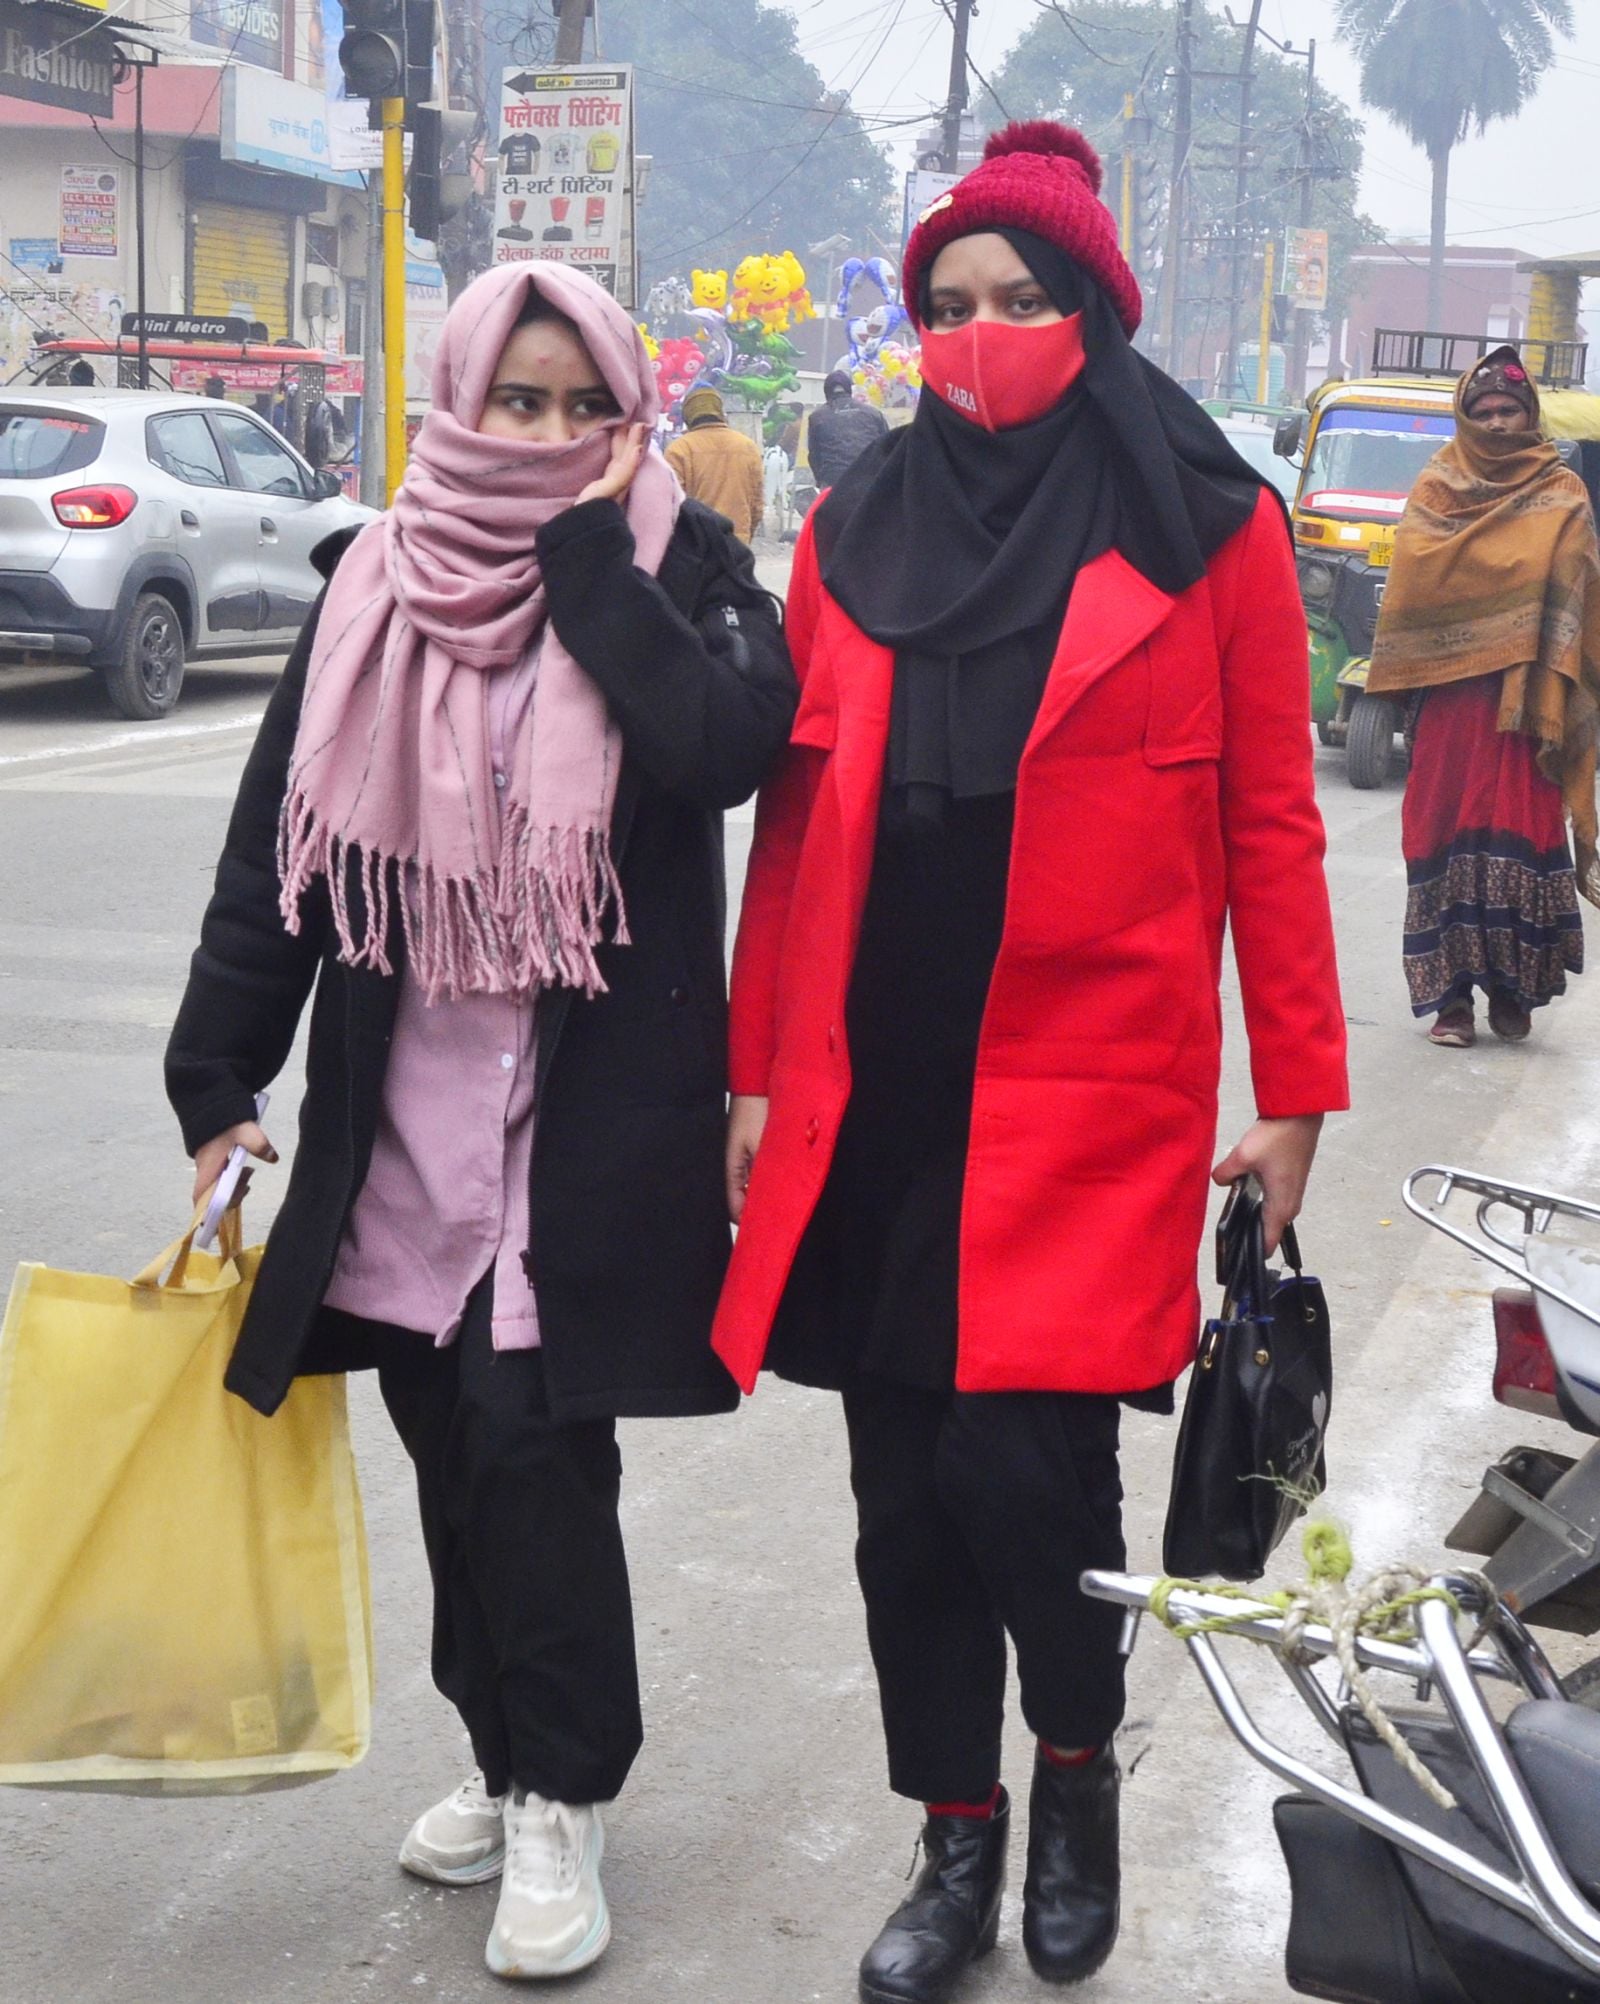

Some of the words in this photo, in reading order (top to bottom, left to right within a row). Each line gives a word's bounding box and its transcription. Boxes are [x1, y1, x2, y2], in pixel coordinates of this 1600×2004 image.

[227, 5, 279, 41] BRIDES
[0, 29, 110, 96] Fashion
[567, 96, 622, 127] प्रिंटिंग
[502, 176, 555, 194] टी-शर्ट
[174, 320, 226, 334] Metro
[946, 382, 977, 412] ZARA
